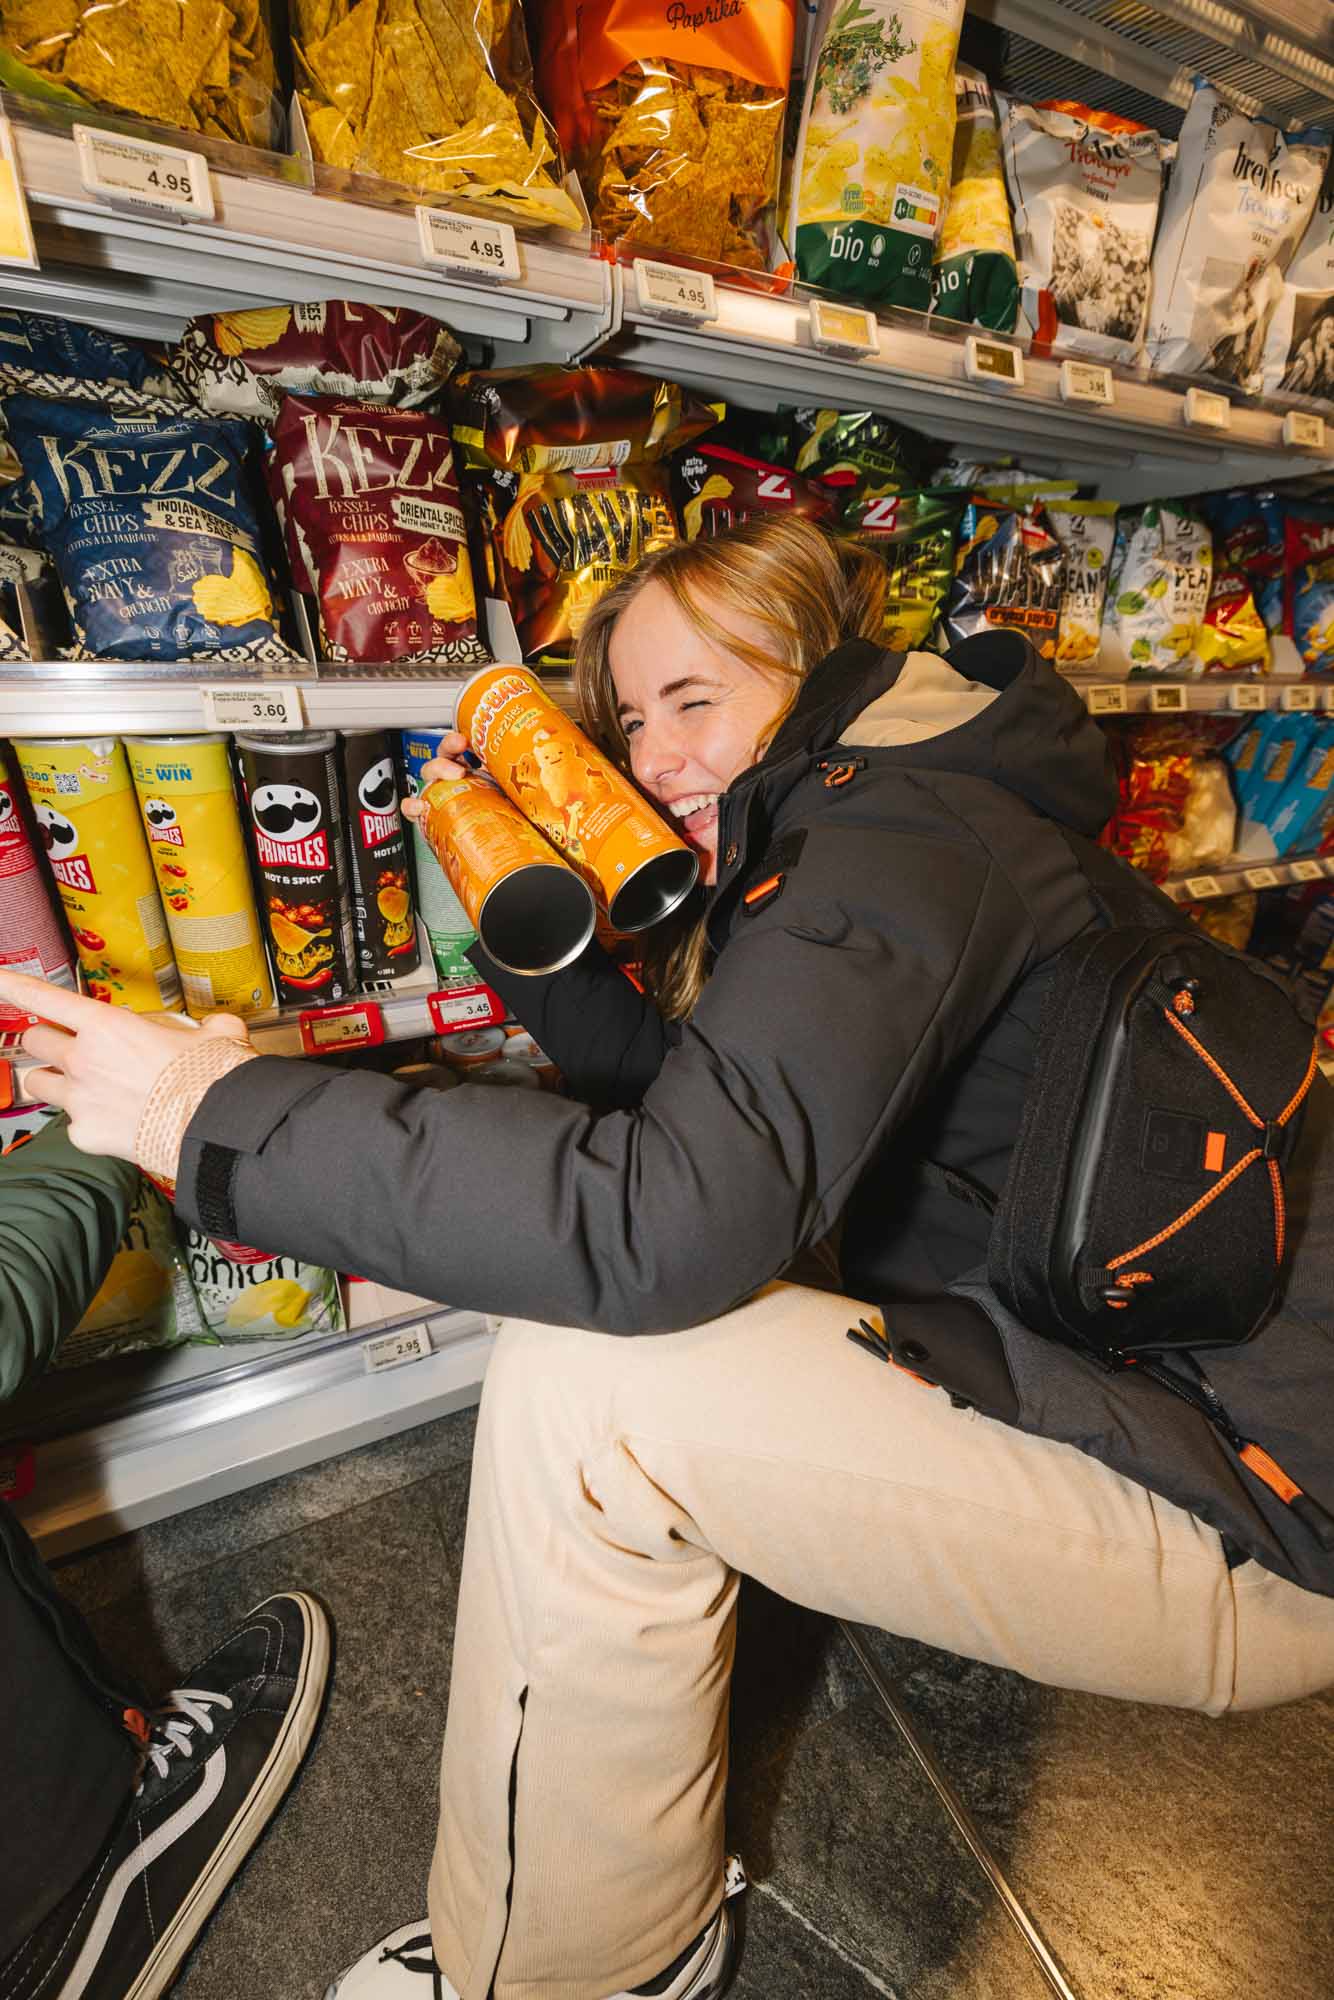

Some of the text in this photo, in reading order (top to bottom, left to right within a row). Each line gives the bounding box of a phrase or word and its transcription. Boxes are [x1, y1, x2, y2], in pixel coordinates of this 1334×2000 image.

[666, 0, 742, 32] Paprika
[147, 170, 192, 194] 4.95
[470, 240, 503, 259] 4.95
[829, 228, 864, 262] bio
[678, 287, 705, 303] 4.95
[114, 424, 160, 434] ZWEIFEL
[299, 413, 460, 499] KEZZ
[37, 435, 237, 512] KEZZ
[69, 501, 124, 519] KESSEL-
[157, 500, 198, 515] INDIAN
[328, 500, 377, 514] KESSEL-
[400, 501, 443, 523] ORIENTAL
[83, 512, 139, 534] CHIPS
[164, 514, 234, 541] & SEA SALT
[342, 512, 389, 532] CHIPS
[343, 556, 390, 577] EXTRA
[592, 566, 619, 581] infe
[1174, 566, 1208, 587] PEA
[136, 584, 155, 599] &
[338, 575, 399, 600] WAVY &
[119, 595, 174, 620] CRUNCHY
[367, 595, 411, 616] CRUNCHY
[252, 704, 286, 717] 3.60
[155, 768, 193, 781] WIN
[256, 831, 327, 867] PRINGLES
[374, 847, 392, 859] HOT
[57, 859, 92, 891] GLES
[264, 871, 324, 886] HOT & SPICY
[466, 1003, 490, 1015] 3.45
[342, 1023, 369, 1036] 3.45
[191, 1251, 300, 1290] onion
